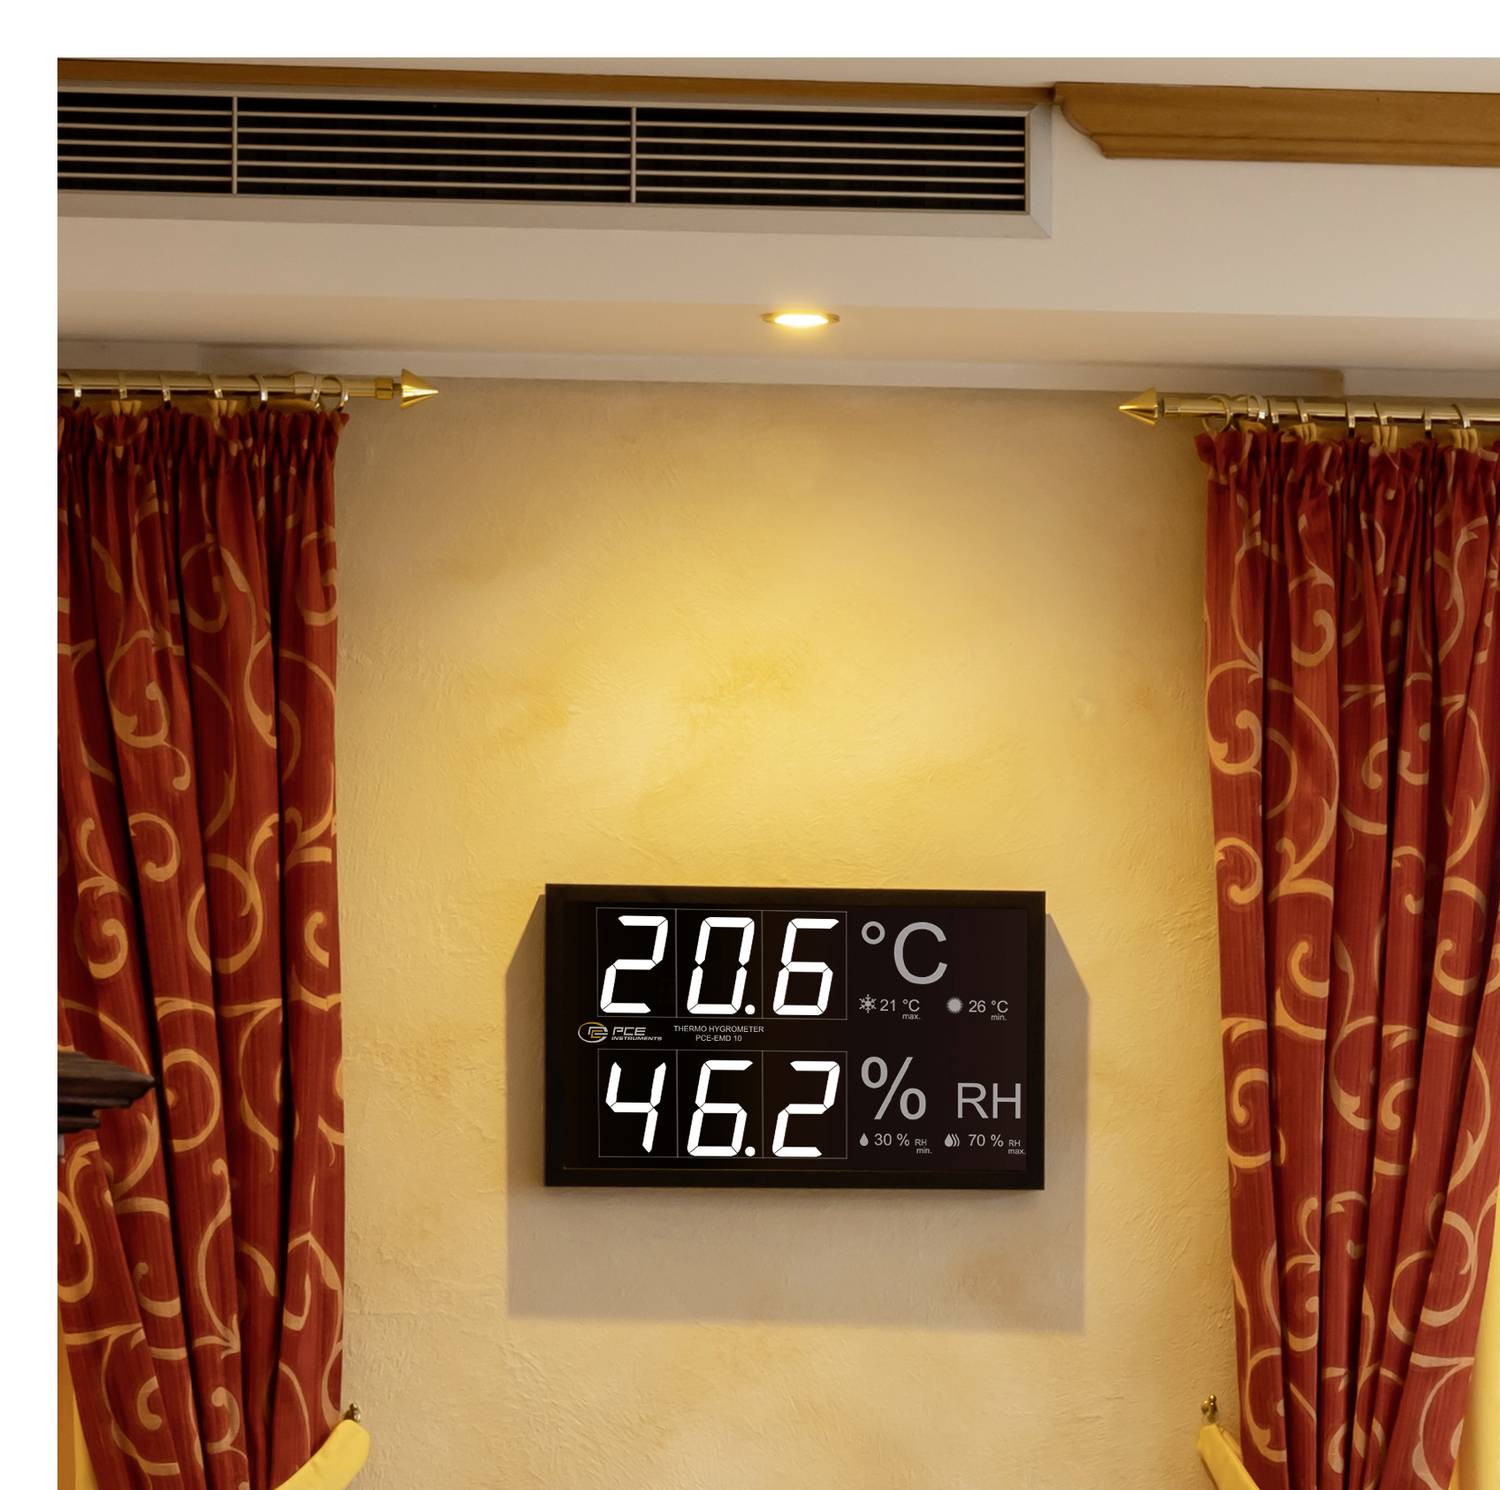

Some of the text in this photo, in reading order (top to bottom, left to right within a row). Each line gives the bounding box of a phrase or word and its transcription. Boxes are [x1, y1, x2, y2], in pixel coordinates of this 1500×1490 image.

[600, 914, 948, 1016] 20.6 °C
[879, 998, 921, 1013] 21 °C
[968, 1000, 1009, 1014] 26 °C
[612, 1026, 647, 1036] PCE
[673, 1025, 765, 1033] THERMO HYGROMETER
[695, 1034, 732, 1042] PCE-EMD
[605, 1056, 1022, 1158] 46.2 % RH
[873, 1133, 927, 1147] 30 % RH
[968, 1134, 1021, 1148] 70 % RH
[1008, 1148, 1026, 1156] max.
